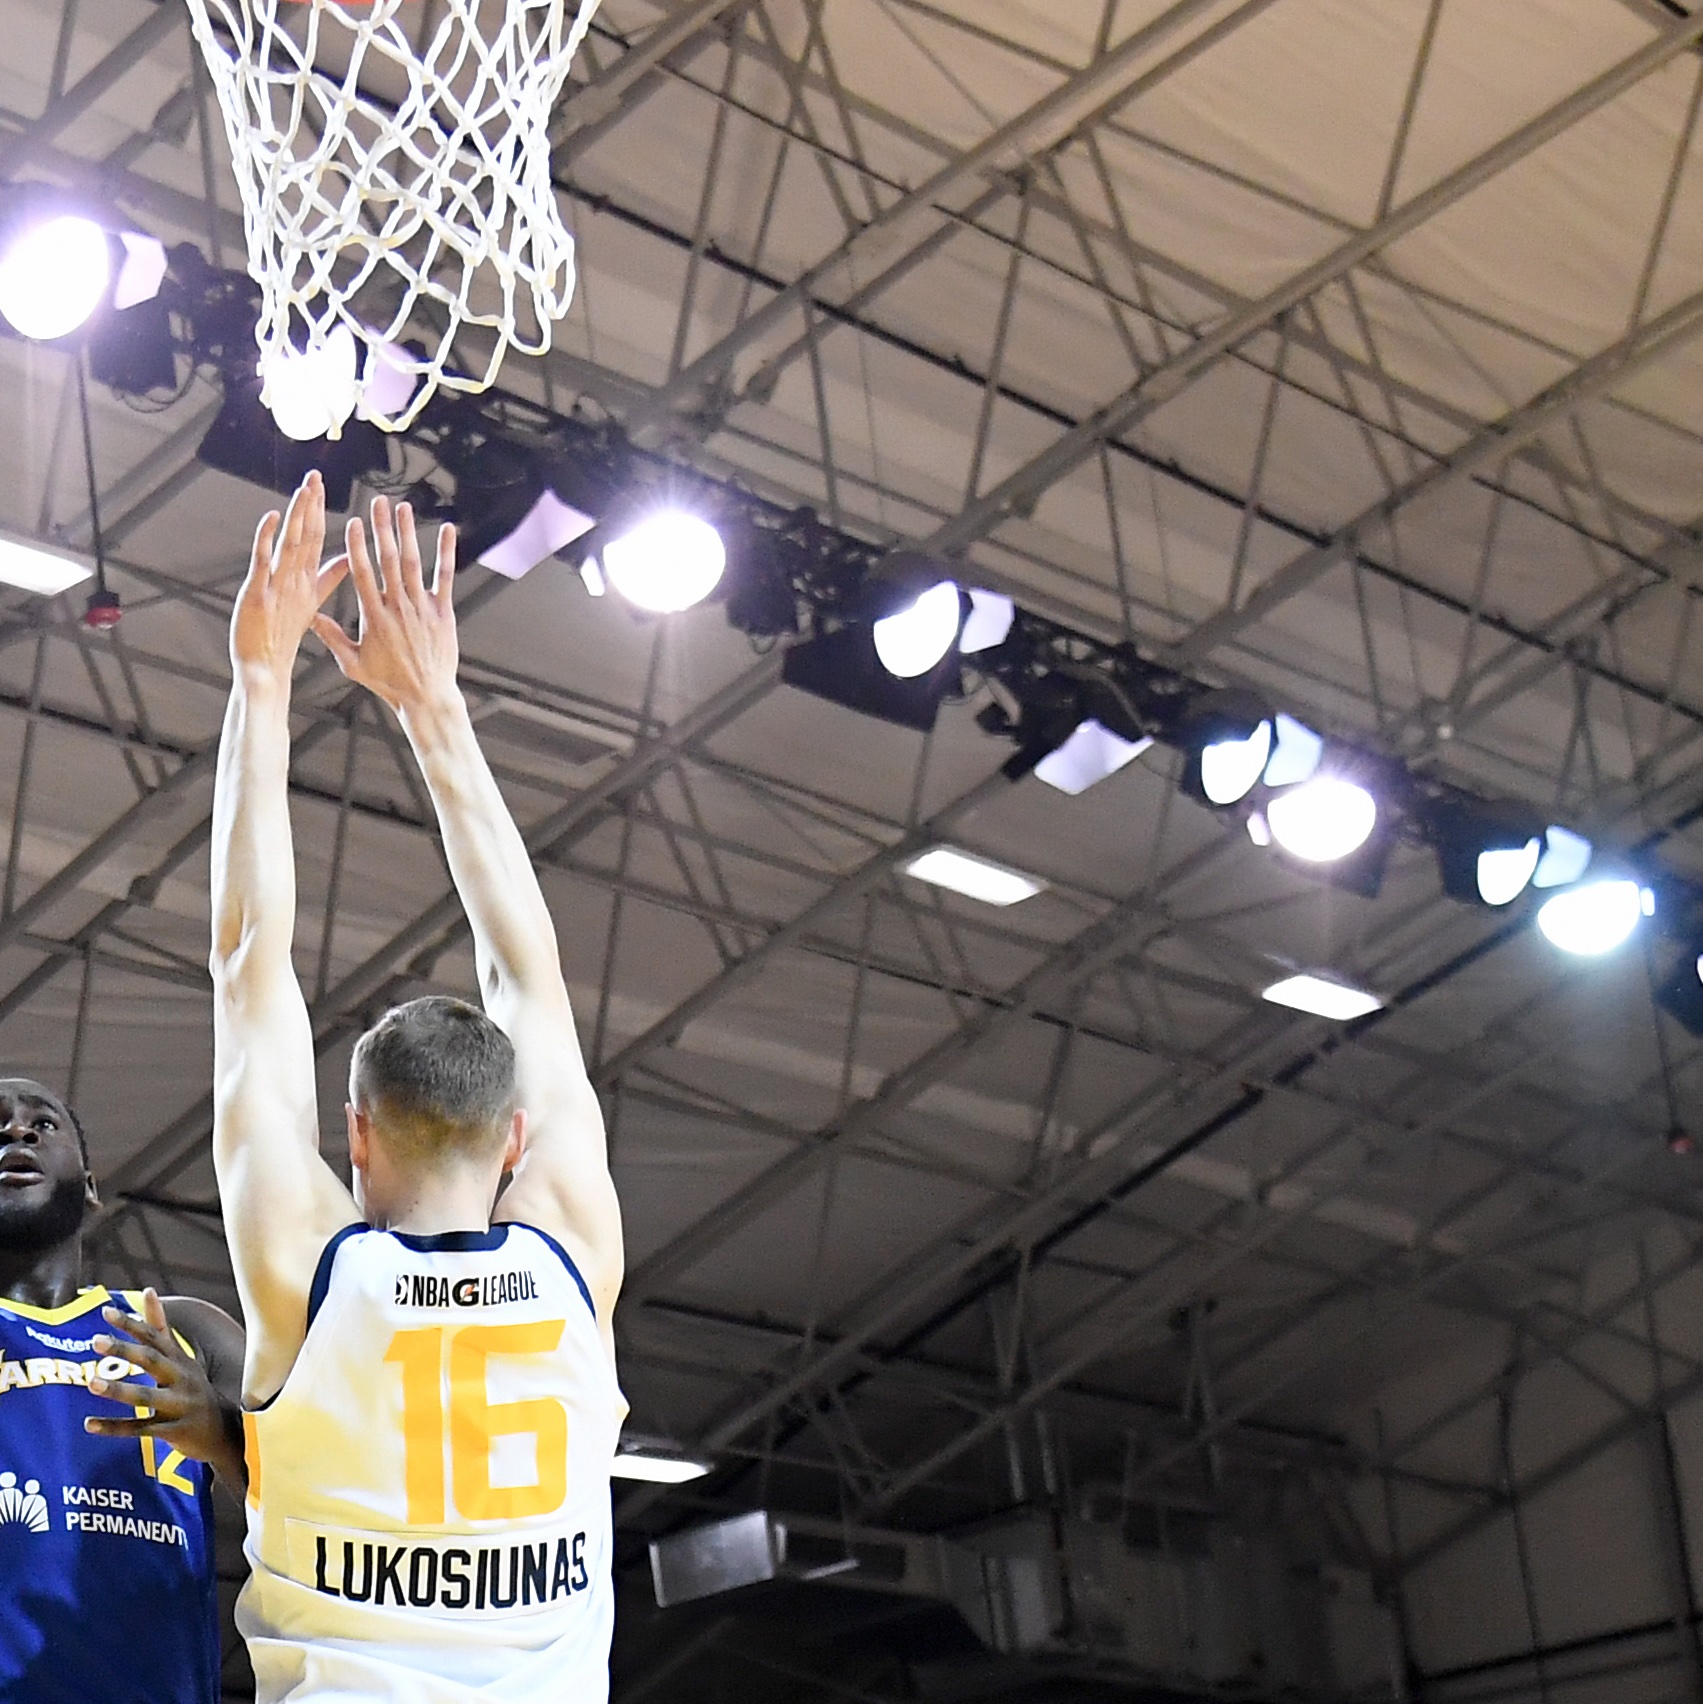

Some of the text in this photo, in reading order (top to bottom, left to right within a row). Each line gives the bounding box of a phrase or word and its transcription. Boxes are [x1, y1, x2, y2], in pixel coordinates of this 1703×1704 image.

[412, 1275, 450, 1307] NBA
[482, 1271, 539, 1306] LEAGUE
[383, 1319, 568, 1525] 16
[62, 1486, 134, 1510] KAISER
[316, 1532, 589, 1610] LUKOSIUNAS
